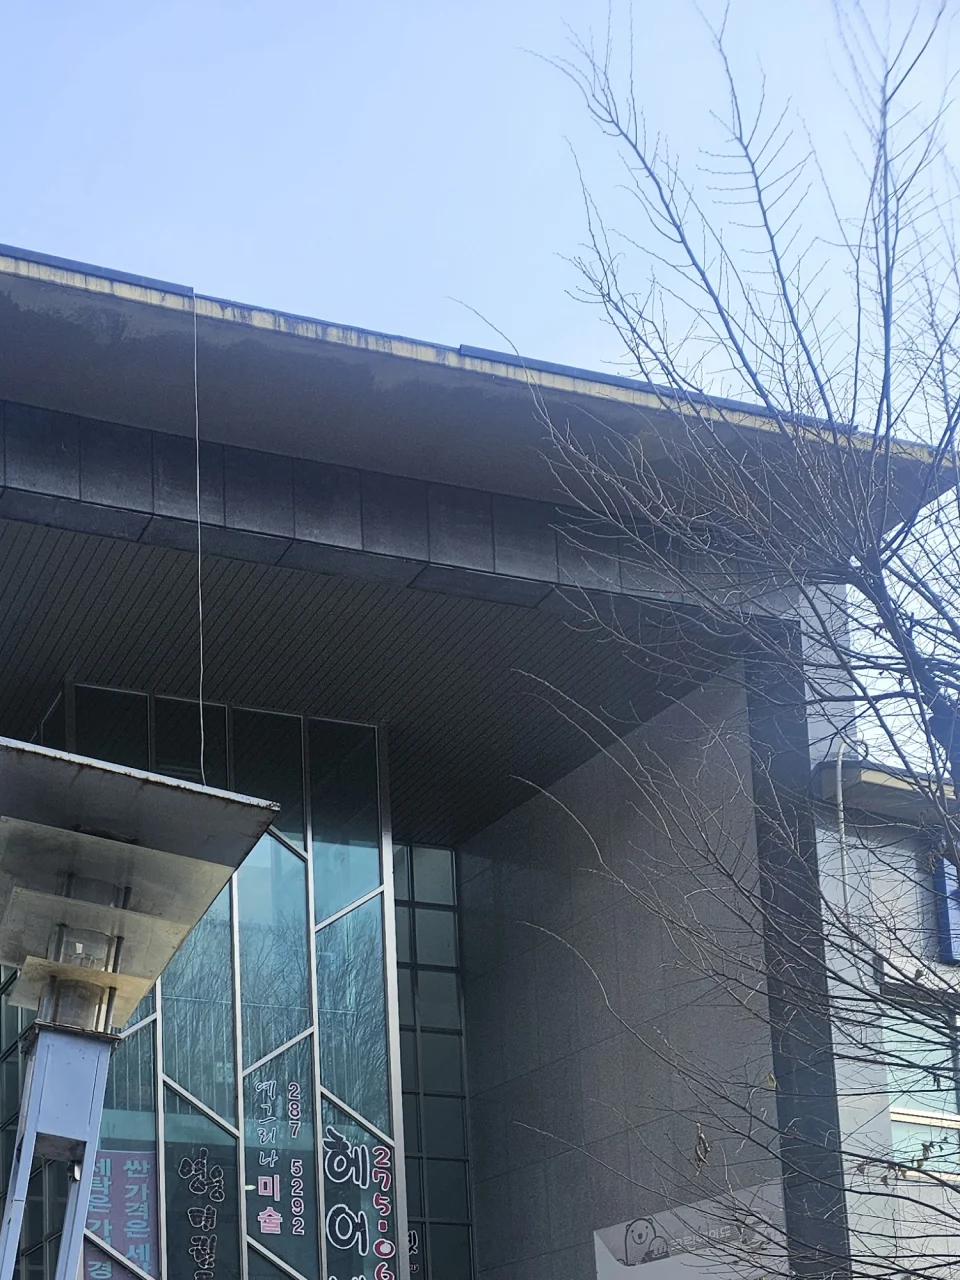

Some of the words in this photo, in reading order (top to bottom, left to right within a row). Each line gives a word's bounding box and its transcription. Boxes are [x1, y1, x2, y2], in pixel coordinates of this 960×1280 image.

[123, 1159, 151, 1178] 싼
[123, 1184, 151, 1238] 가격은
[258, 1174, 283, 1234] 미술
